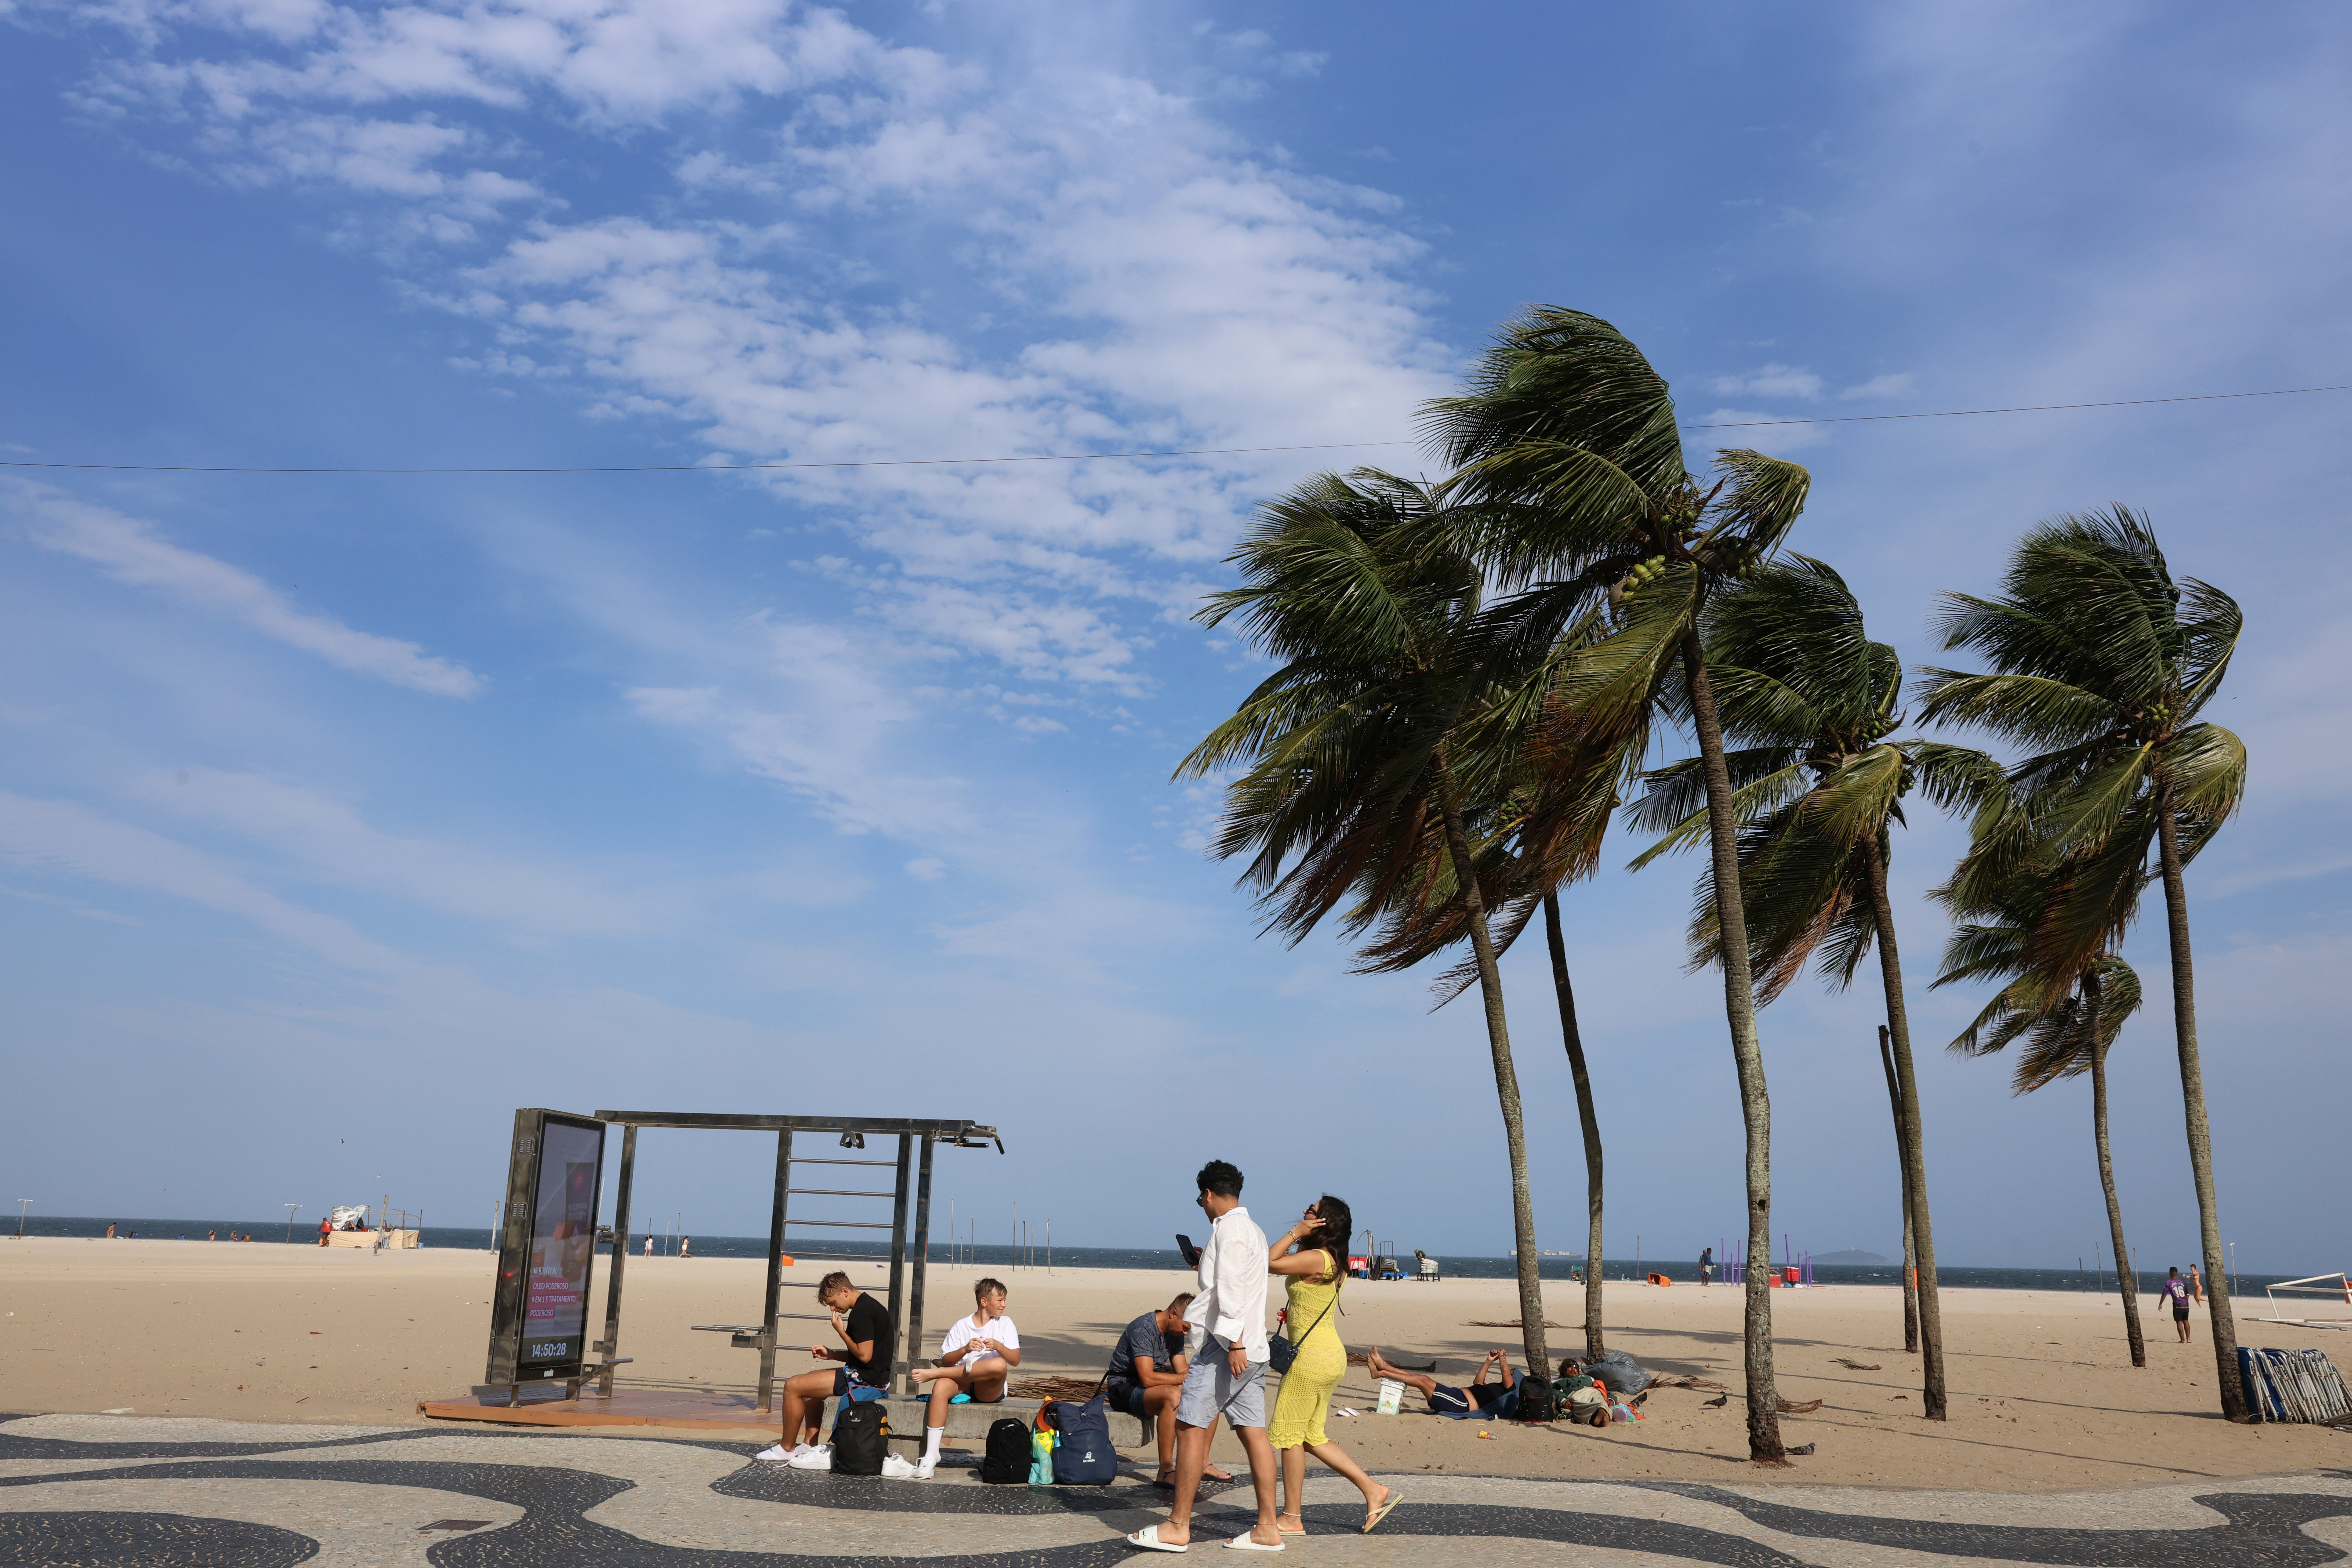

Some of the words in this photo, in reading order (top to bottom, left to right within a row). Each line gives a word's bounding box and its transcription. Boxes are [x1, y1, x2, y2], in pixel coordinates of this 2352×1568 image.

[534, 1267, 556, 1275] KOLESTON
[533, 1281, 545, 1290] ÓLEO
[2173, 1286, 2185, 1298] 16
[532, 1342, 566, 1357] 14:50:28
